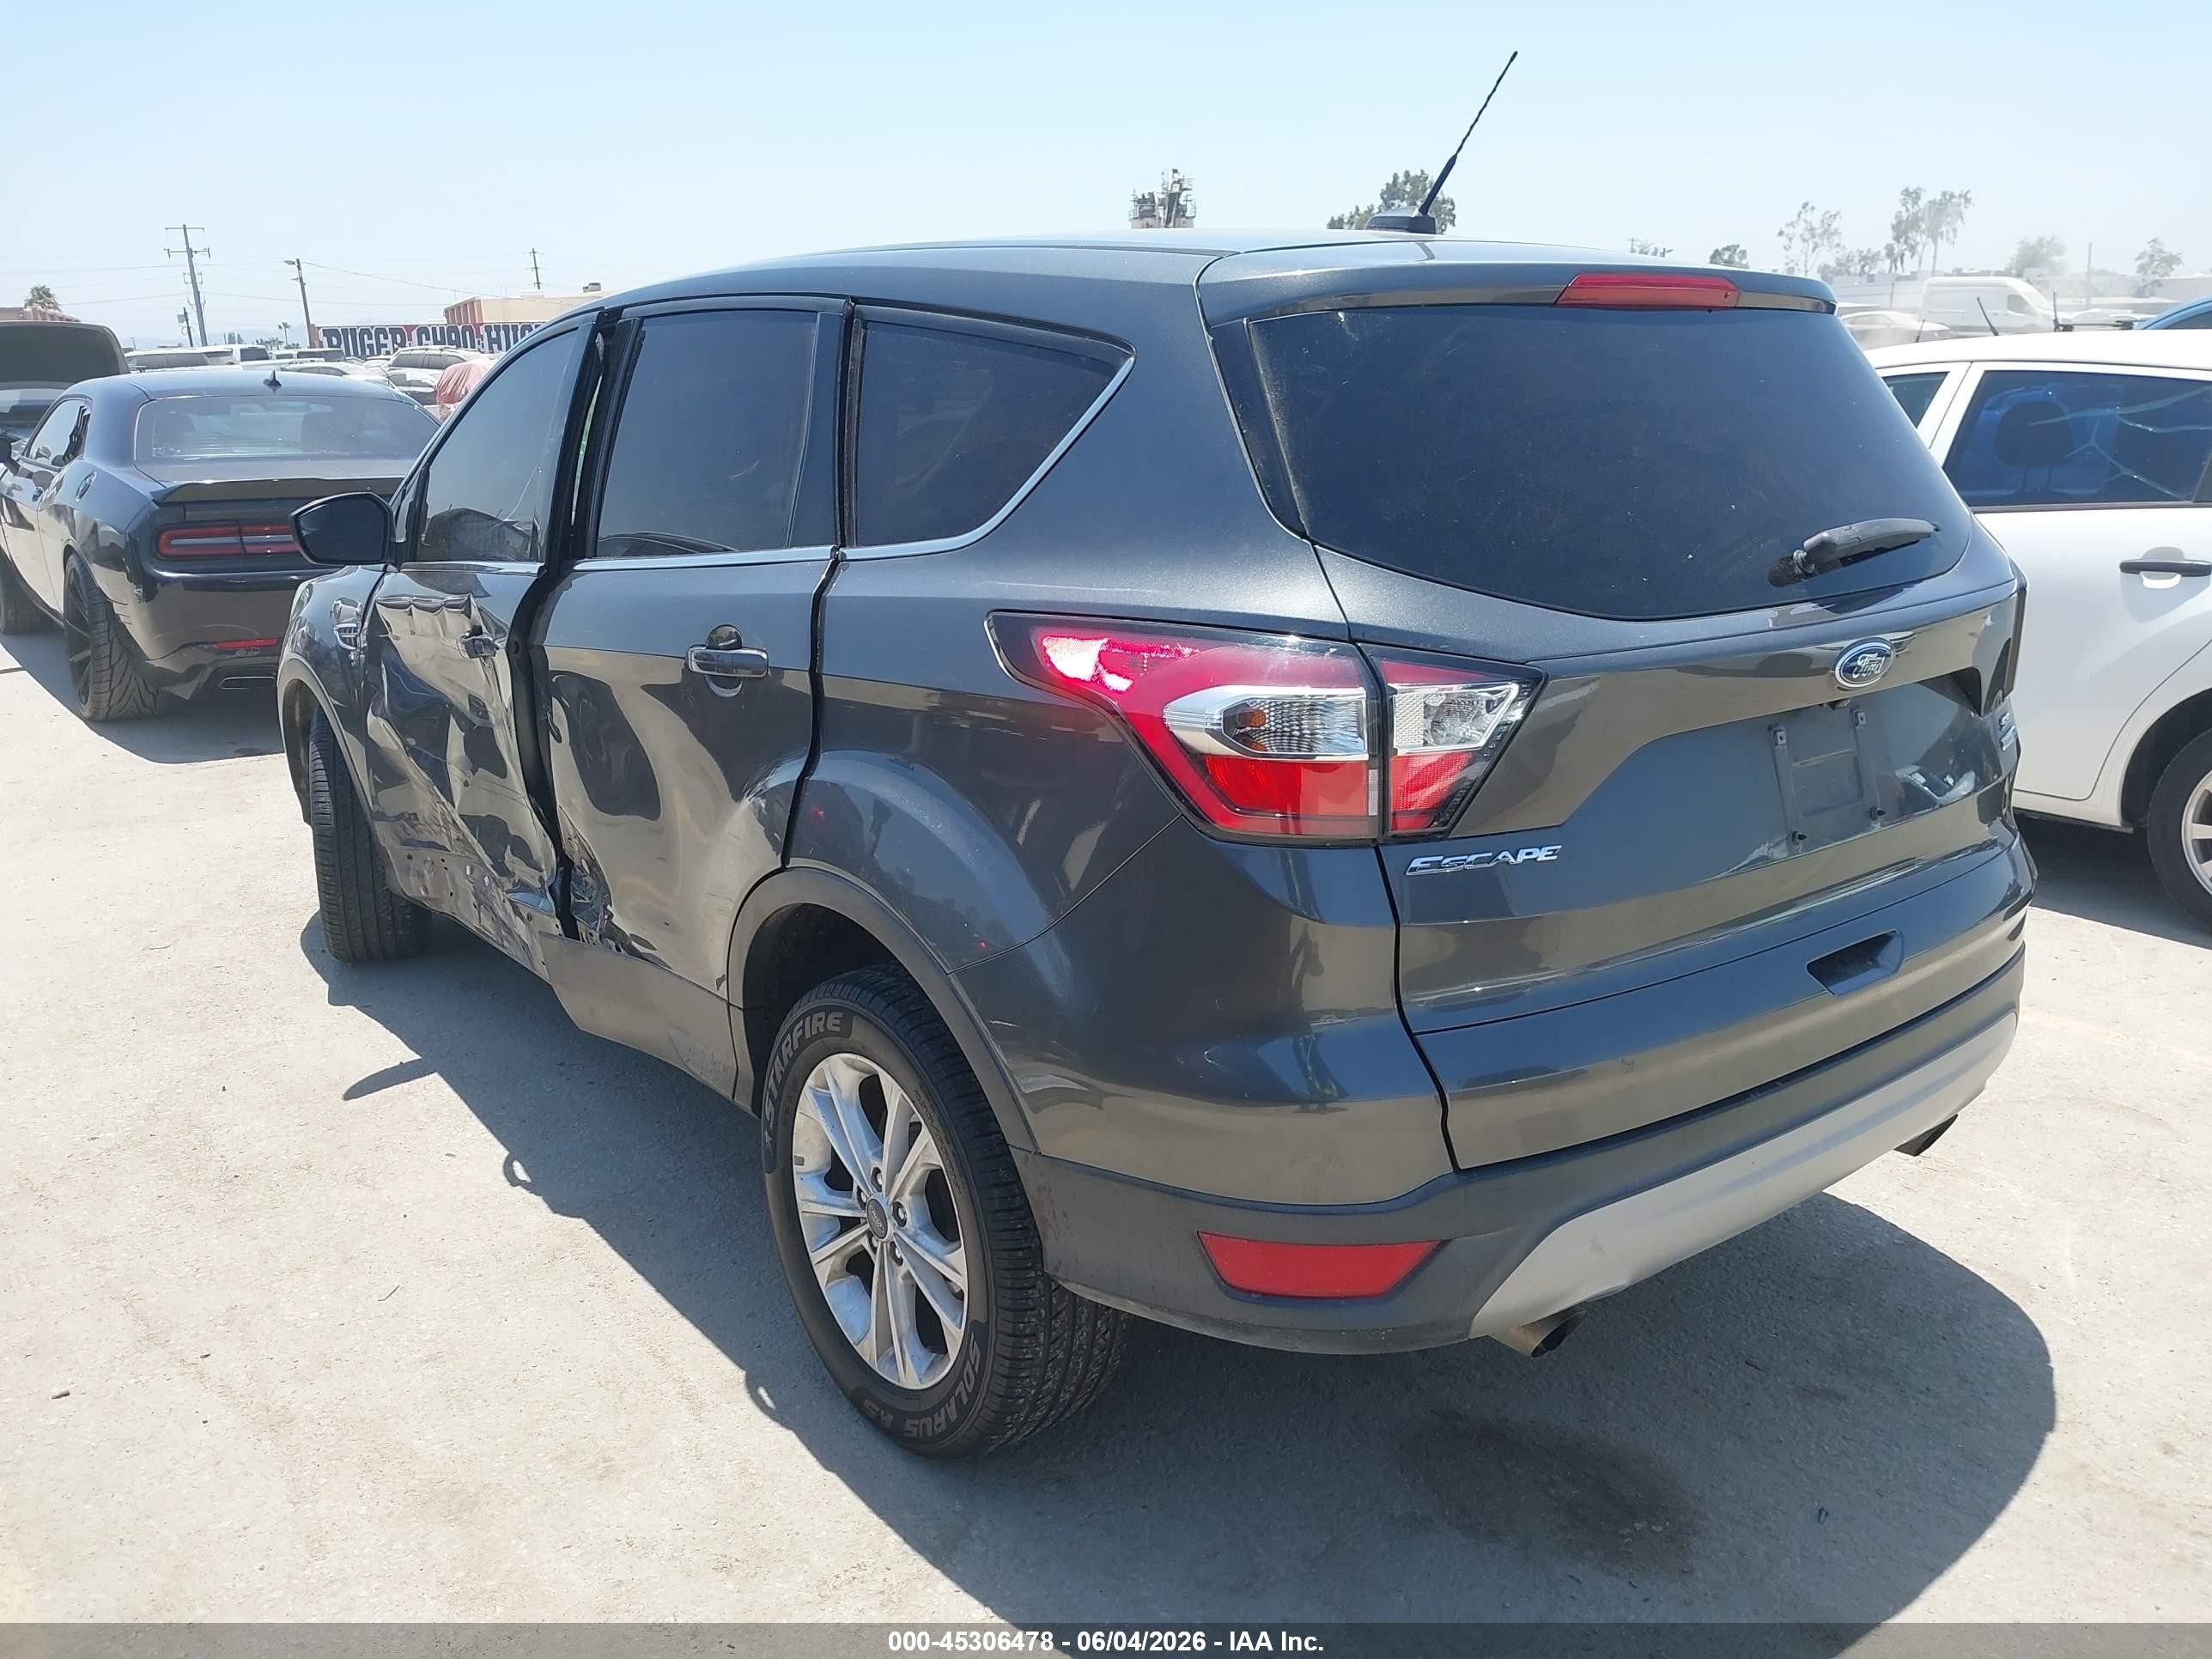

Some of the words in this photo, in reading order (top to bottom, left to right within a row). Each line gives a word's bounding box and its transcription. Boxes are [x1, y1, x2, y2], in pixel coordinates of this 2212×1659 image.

[1852, 653, 1886, 678] Ford
[1406, 845, 1562, 875] ESCAPE
[764, 1012, 843, 1127] STARFIRE
[904, 1332, 981, 1438] SOLARUS
